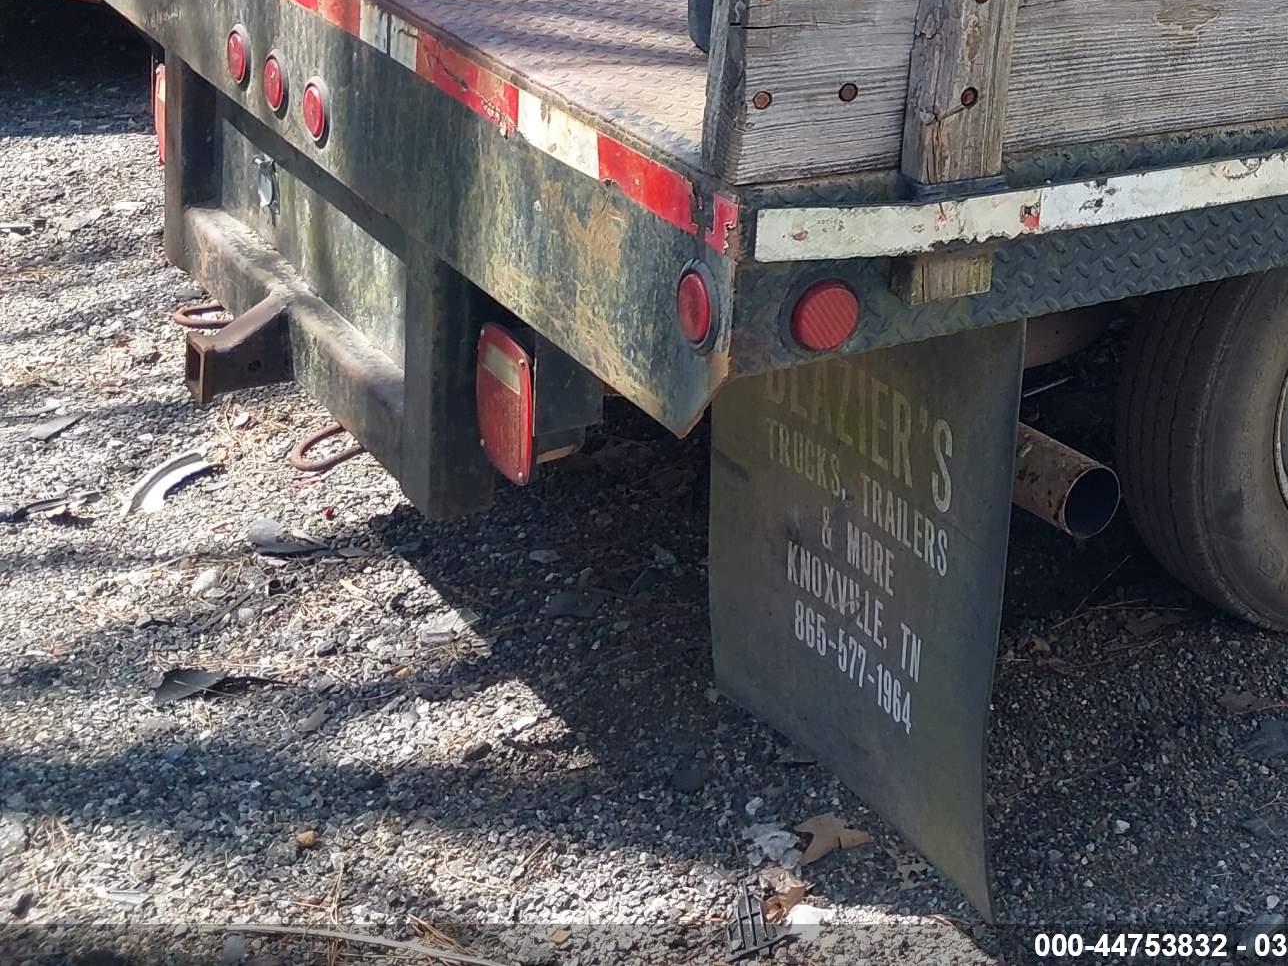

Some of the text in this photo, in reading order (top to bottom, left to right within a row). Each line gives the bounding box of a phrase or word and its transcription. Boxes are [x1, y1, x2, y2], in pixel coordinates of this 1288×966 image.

[764, 417, 948, 577] TRUCKS, TRAILERS
[821, 506, 895, 597] & MORE
[787, 540, 922, 683] KNOXVILLE, TN
[794, 600, 912, 735] 865-577-1964
